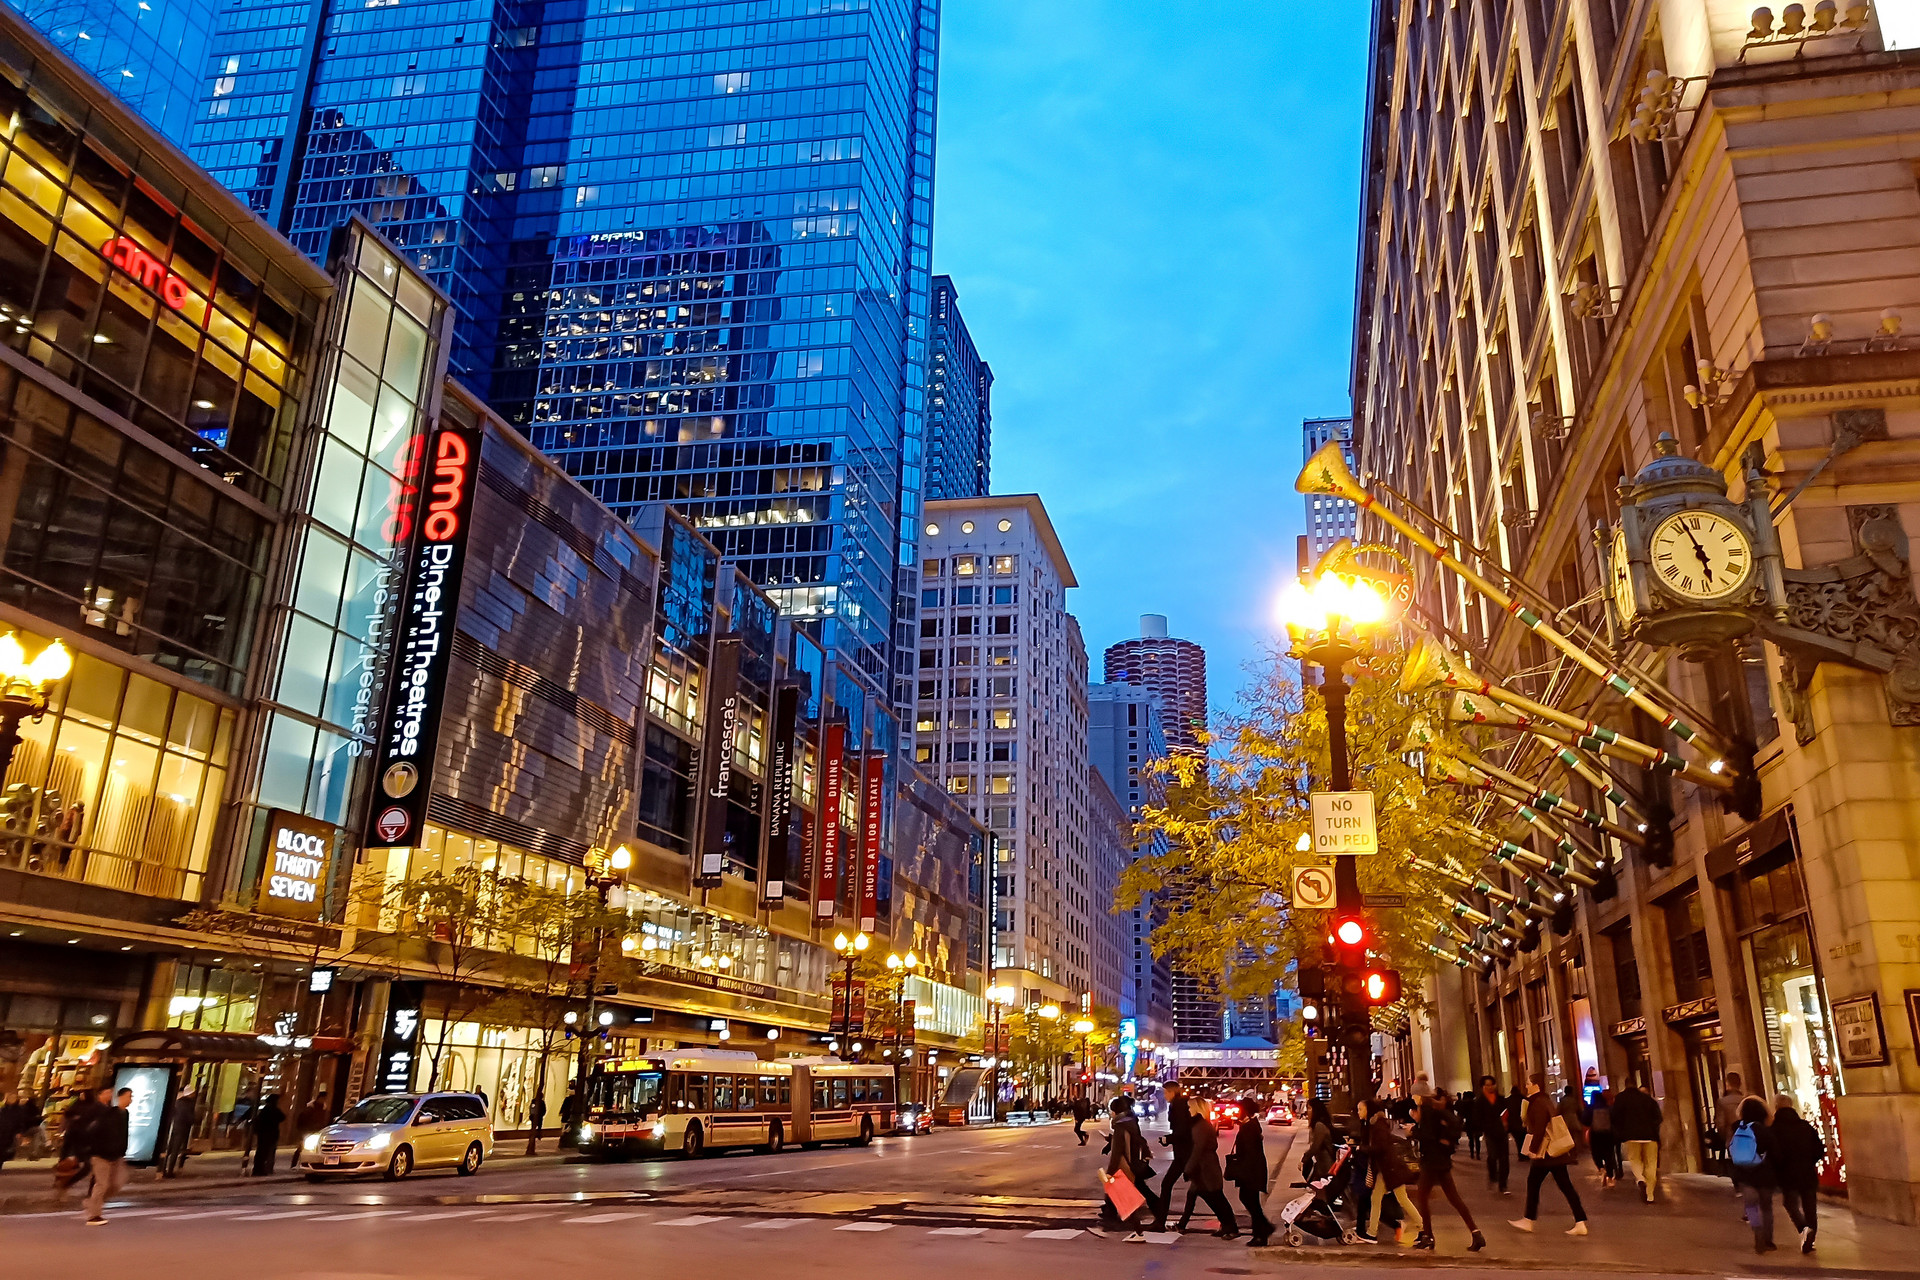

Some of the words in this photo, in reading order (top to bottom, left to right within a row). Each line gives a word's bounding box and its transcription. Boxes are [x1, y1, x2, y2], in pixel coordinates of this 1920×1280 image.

[102, 235, 187, 310] amc
[424, 431, 468, 541] amc
[419, 544, 454, 635] Dine-In
[400, 632, 439, 757] Theatres
[389, 705, 405, 758] MORE
[710, 697, 735, 798] francesca's
[774, 741, 785, 791] REPUBLIC
[828, 759, 838, 797] DINING
[782, 763, 792, 814] FACTORY
[870, 777, 878, 807] STATE
[1331, 800, 1353, 811] NO
[770, 793, 781, 837] BANANA
[868, 823, 876, 844] 108
[1326, 817, 1361, 829] TURN
[276, 828, 325, 858] BLOCK
[823, 822, 835, 879] SHOPPING
[867, 846, 875, 859] AT
[1319, 835, 1338, 847] ON
[1343, 834, 1370, 846] RED
[275, 851, 323, 879] THIRTY
[865, 864, 875, 898] SHOPS
[269, 875, 316, 902] SEVEN
